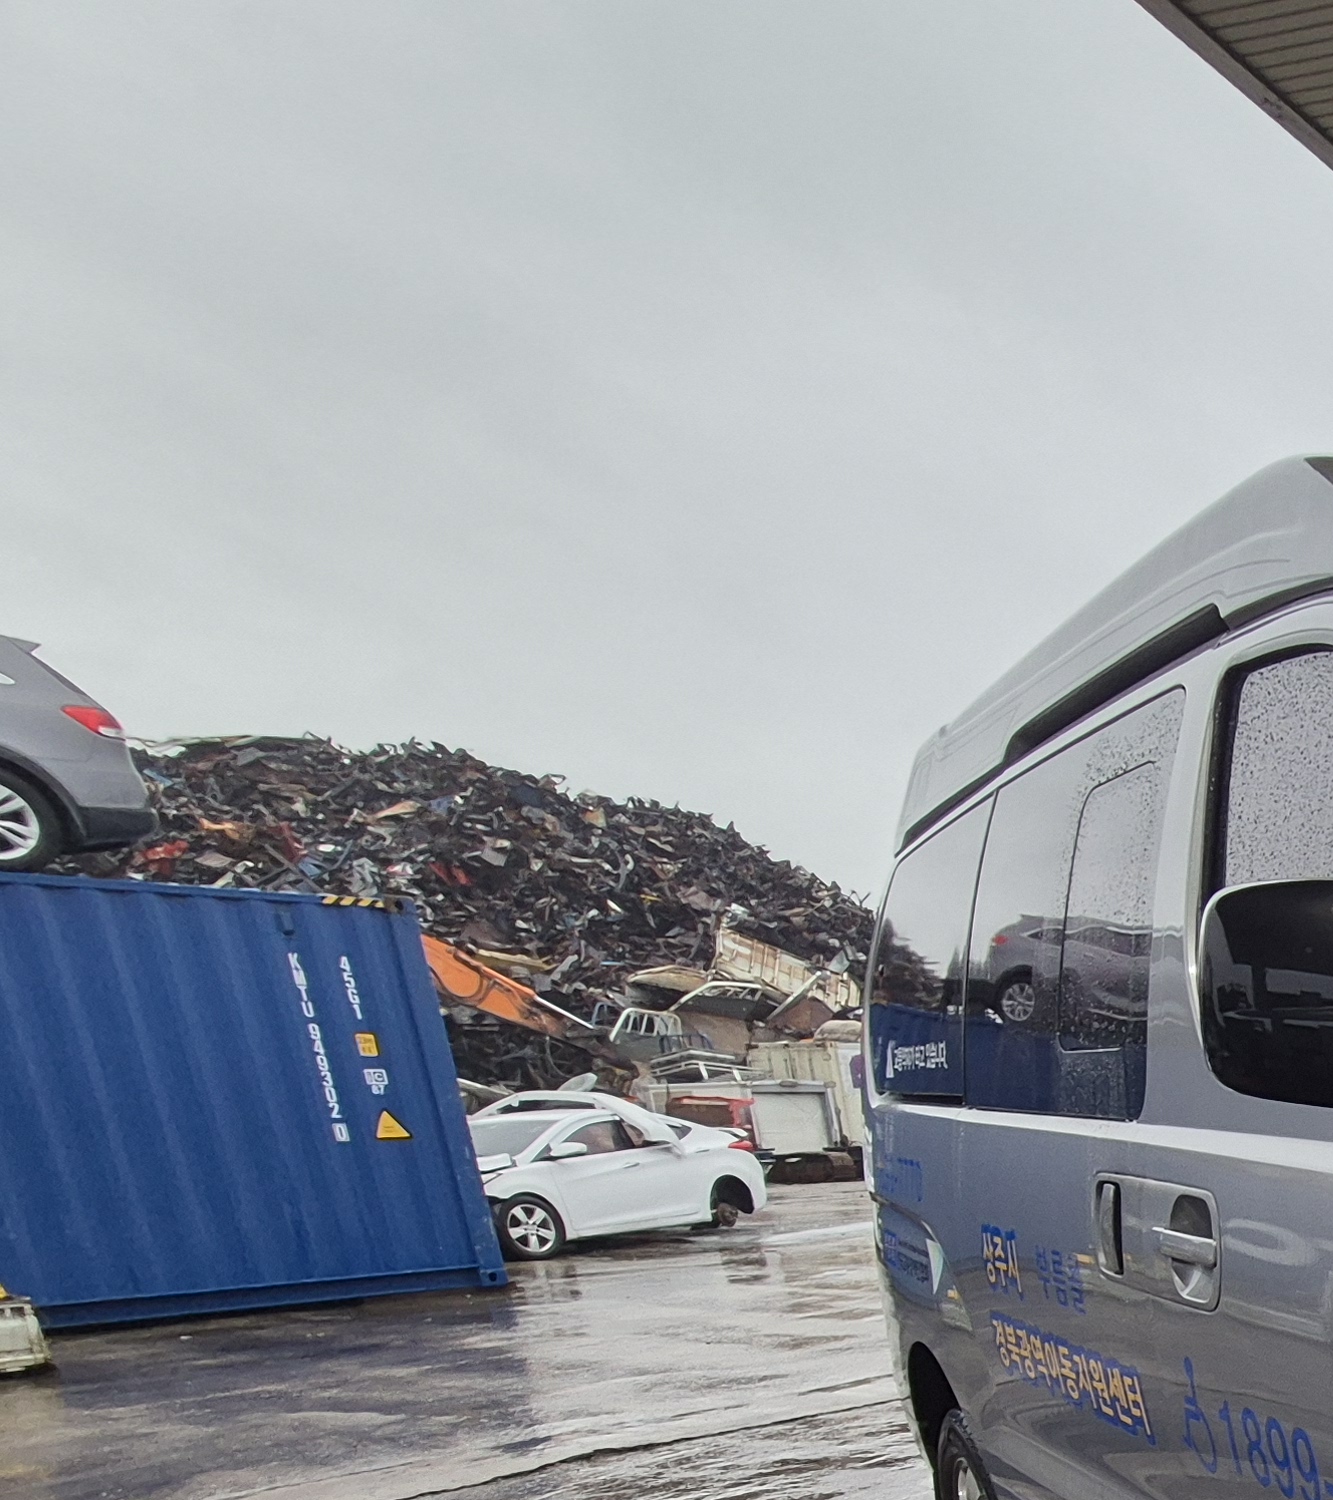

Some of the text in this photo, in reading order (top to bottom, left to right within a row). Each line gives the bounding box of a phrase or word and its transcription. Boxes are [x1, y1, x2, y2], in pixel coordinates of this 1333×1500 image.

[288, 952, 315, 1018] KMTU
[308, 1022, 342, 1118] 949302
[340, 956, 362, 1020] 45G1
[981, 1225, 1023, 1299] 상주시
[990, 1312, 1155, 1443] 경북광역이동지원센터
